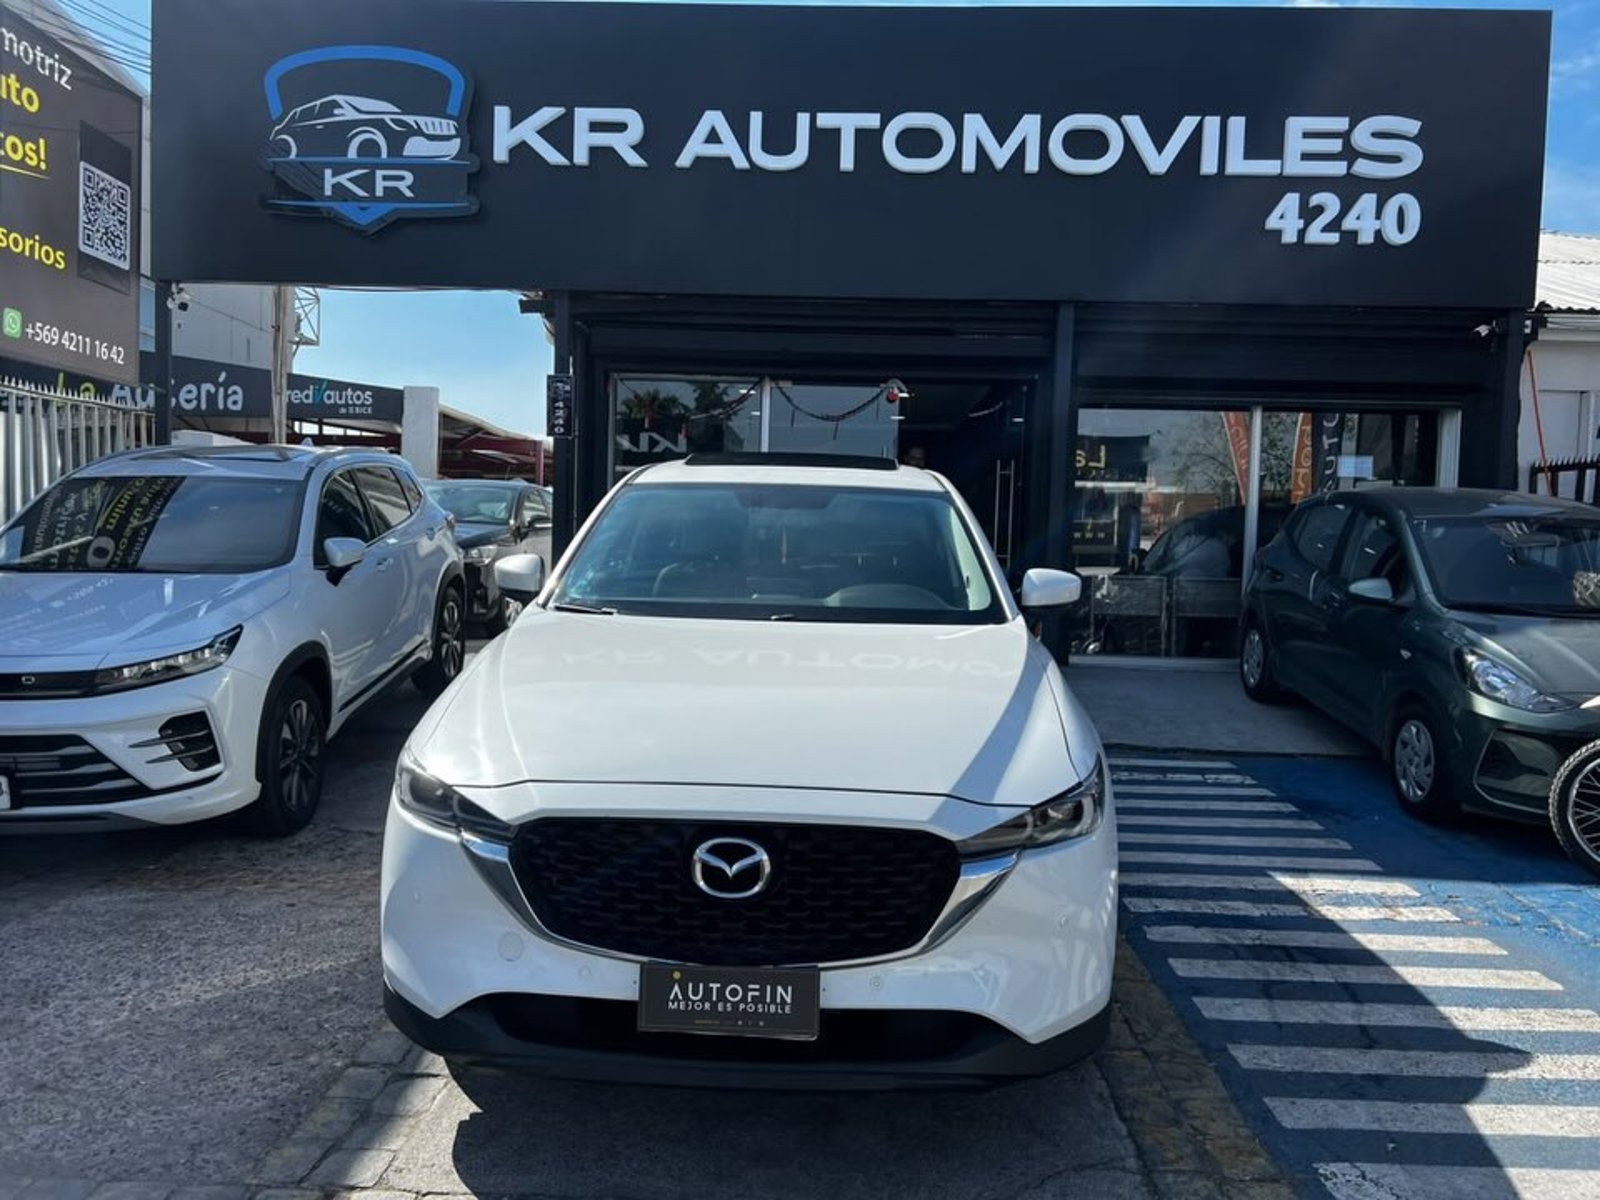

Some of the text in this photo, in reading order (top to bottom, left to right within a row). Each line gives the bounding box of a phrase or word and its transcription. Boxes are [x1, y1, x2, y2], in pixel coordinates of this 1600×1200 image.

[492, 105, 1424, 179] KR AUTOMOVILES
[322, 168, 415, 198] KR
[1264, 191, 1422, 246] 4240
[25, 321, 125, 365] +569 4211 16 42
[111, 371, 244, 412] Auería
[668, 1001, 793, 1014] MEJOR ES POSIBLE
[669, 982, 793, 1004] AUTOFIN
